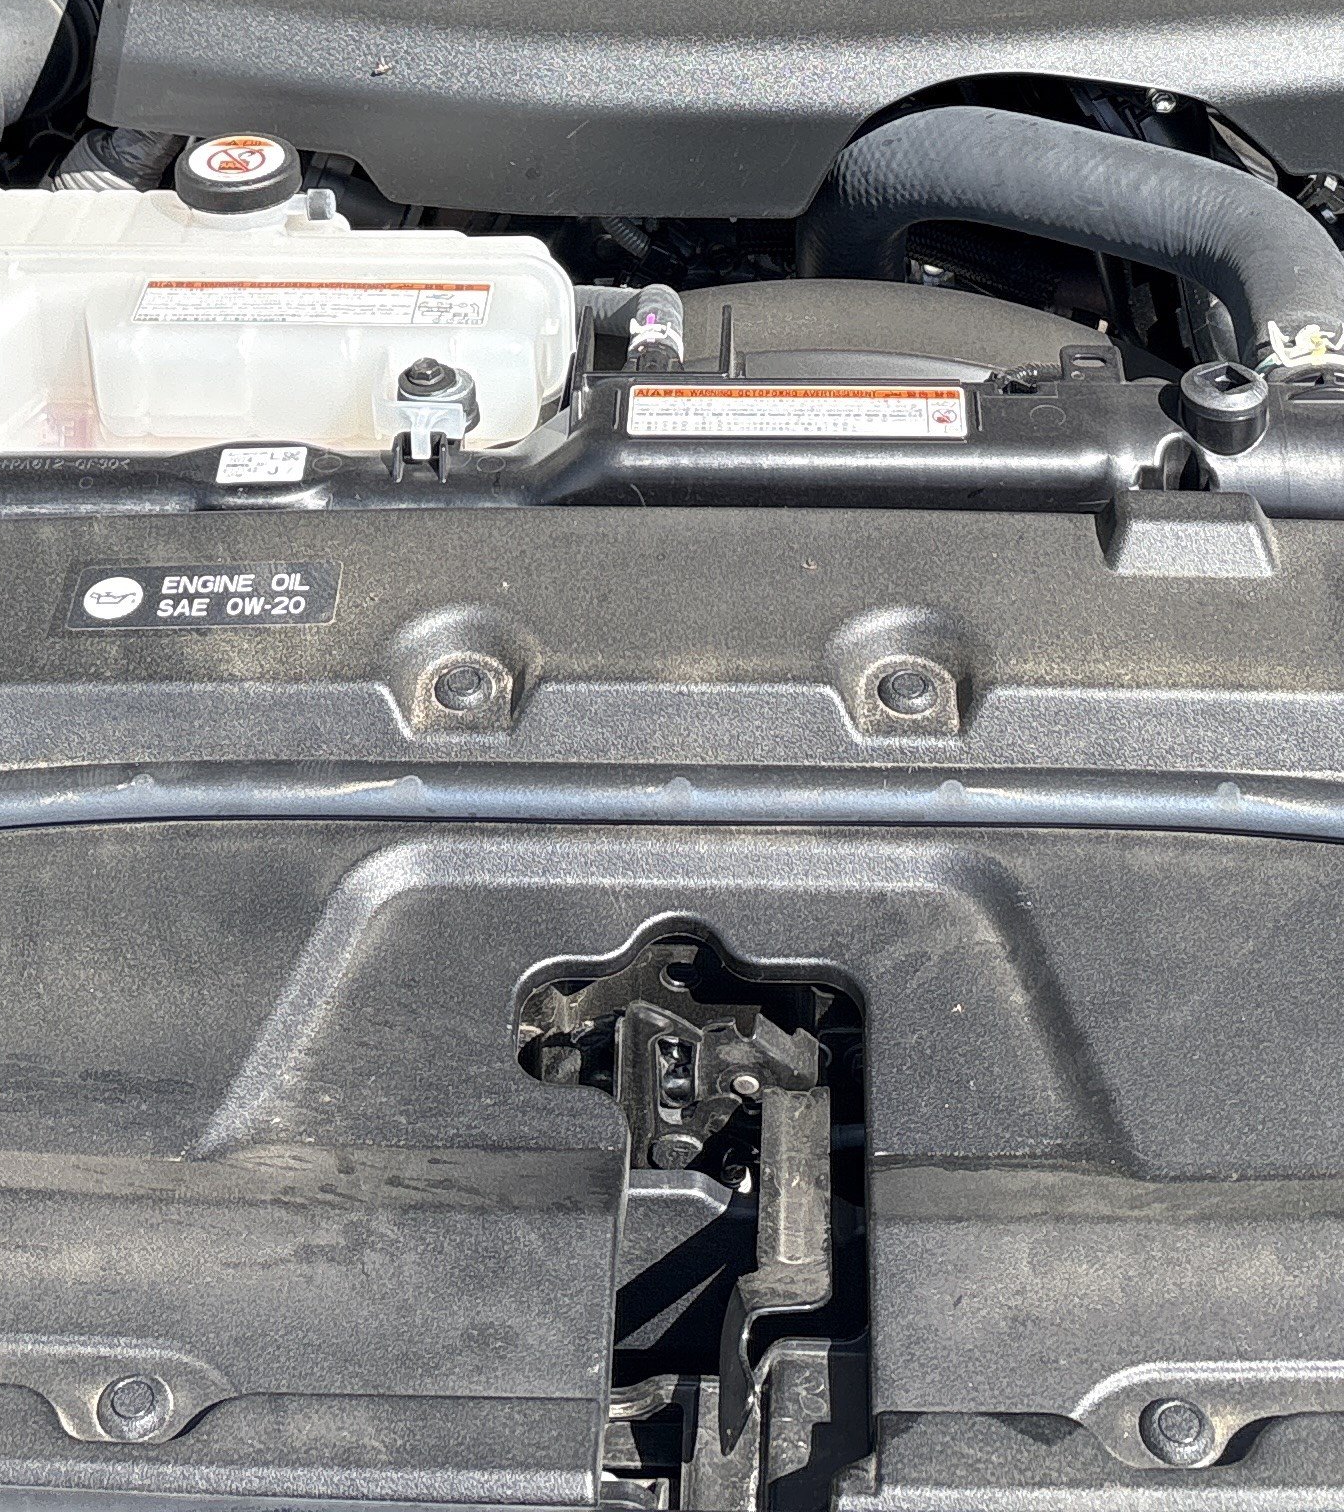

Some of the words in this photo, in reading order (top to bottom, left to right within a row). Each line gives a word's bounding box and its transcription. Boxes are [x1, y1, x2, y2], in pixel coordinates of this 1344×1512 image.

[690, 389, 733, 398] WARNING
[161, 573, 256, 594] ENGINE
[271, 572, 310, 592] OIL
[156, 598, 210, 617] SAE
[225, 596, 306, 616] 0W-20
